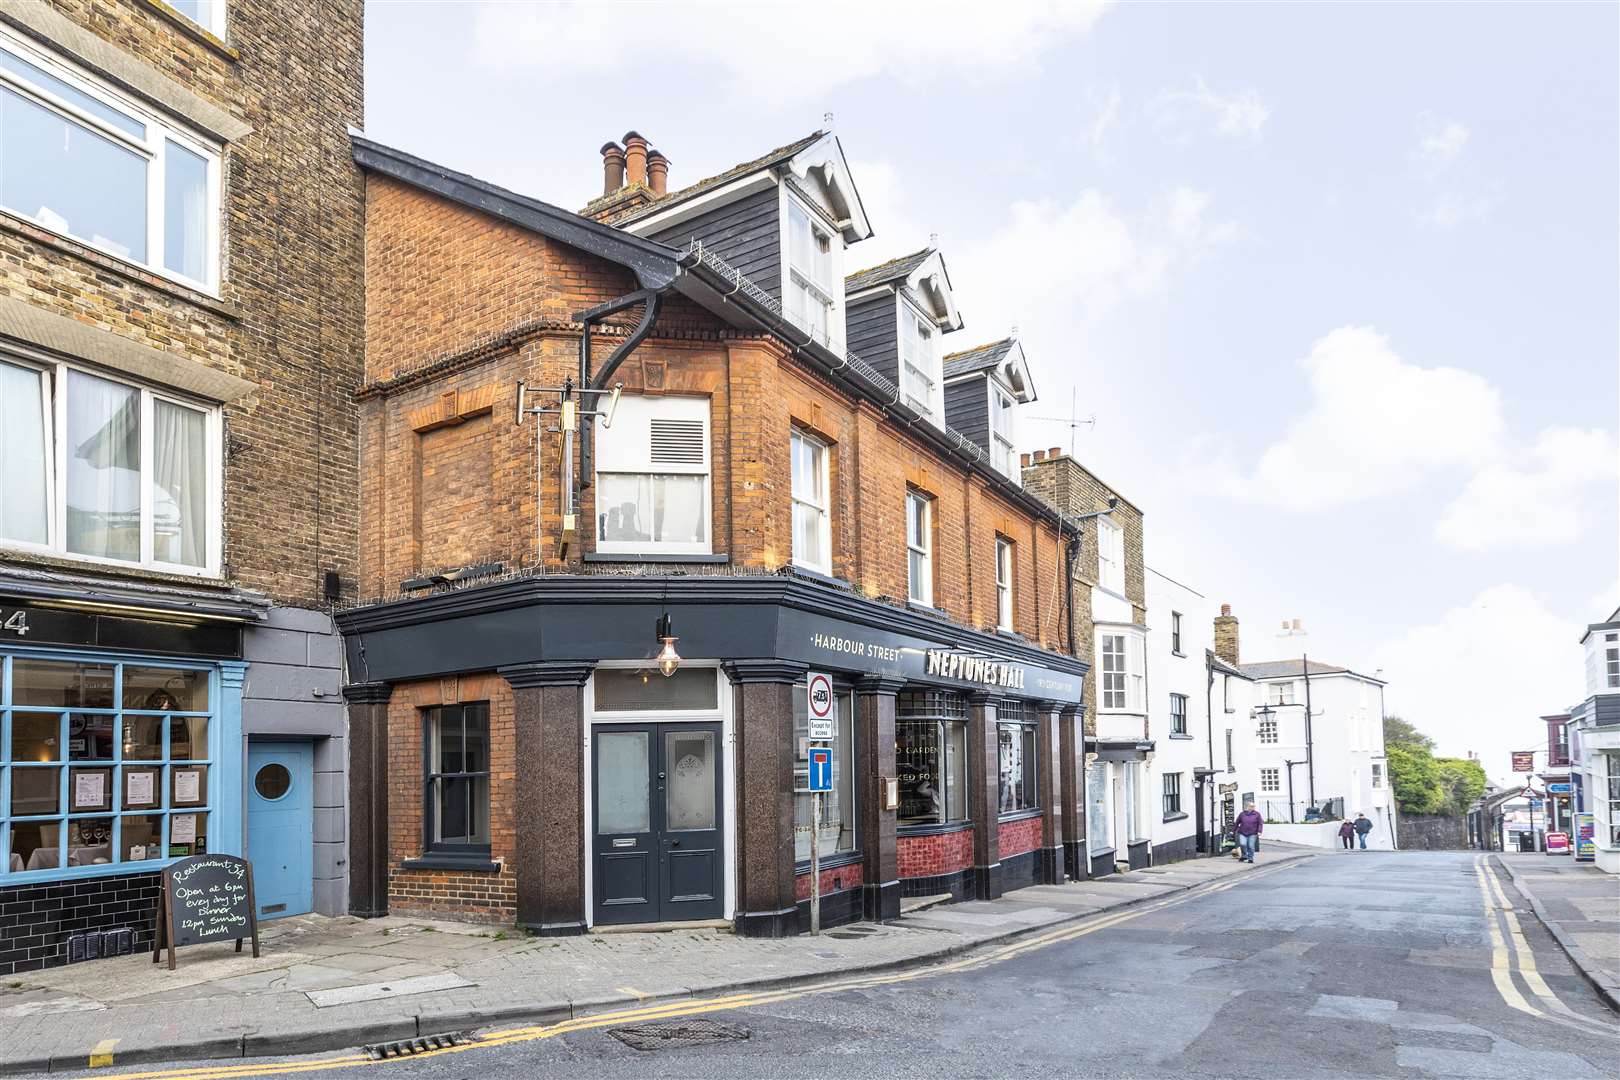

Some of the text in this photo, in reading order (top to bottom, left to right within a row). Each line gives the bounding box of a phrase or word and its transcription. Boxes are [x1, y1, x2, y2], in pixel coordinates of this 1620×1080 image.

[814, 633, 900, 662] HARBOUR STREET
[927, 649, 998, 685] NEPTUNES
[999, 664, 1025, 689] HALL
[173, 860, 232, 884] Restaurant
[176, 887, 204, 900] Open
[209, 885, 220, 893] at
[199, 925, 229, 936] Lunch
